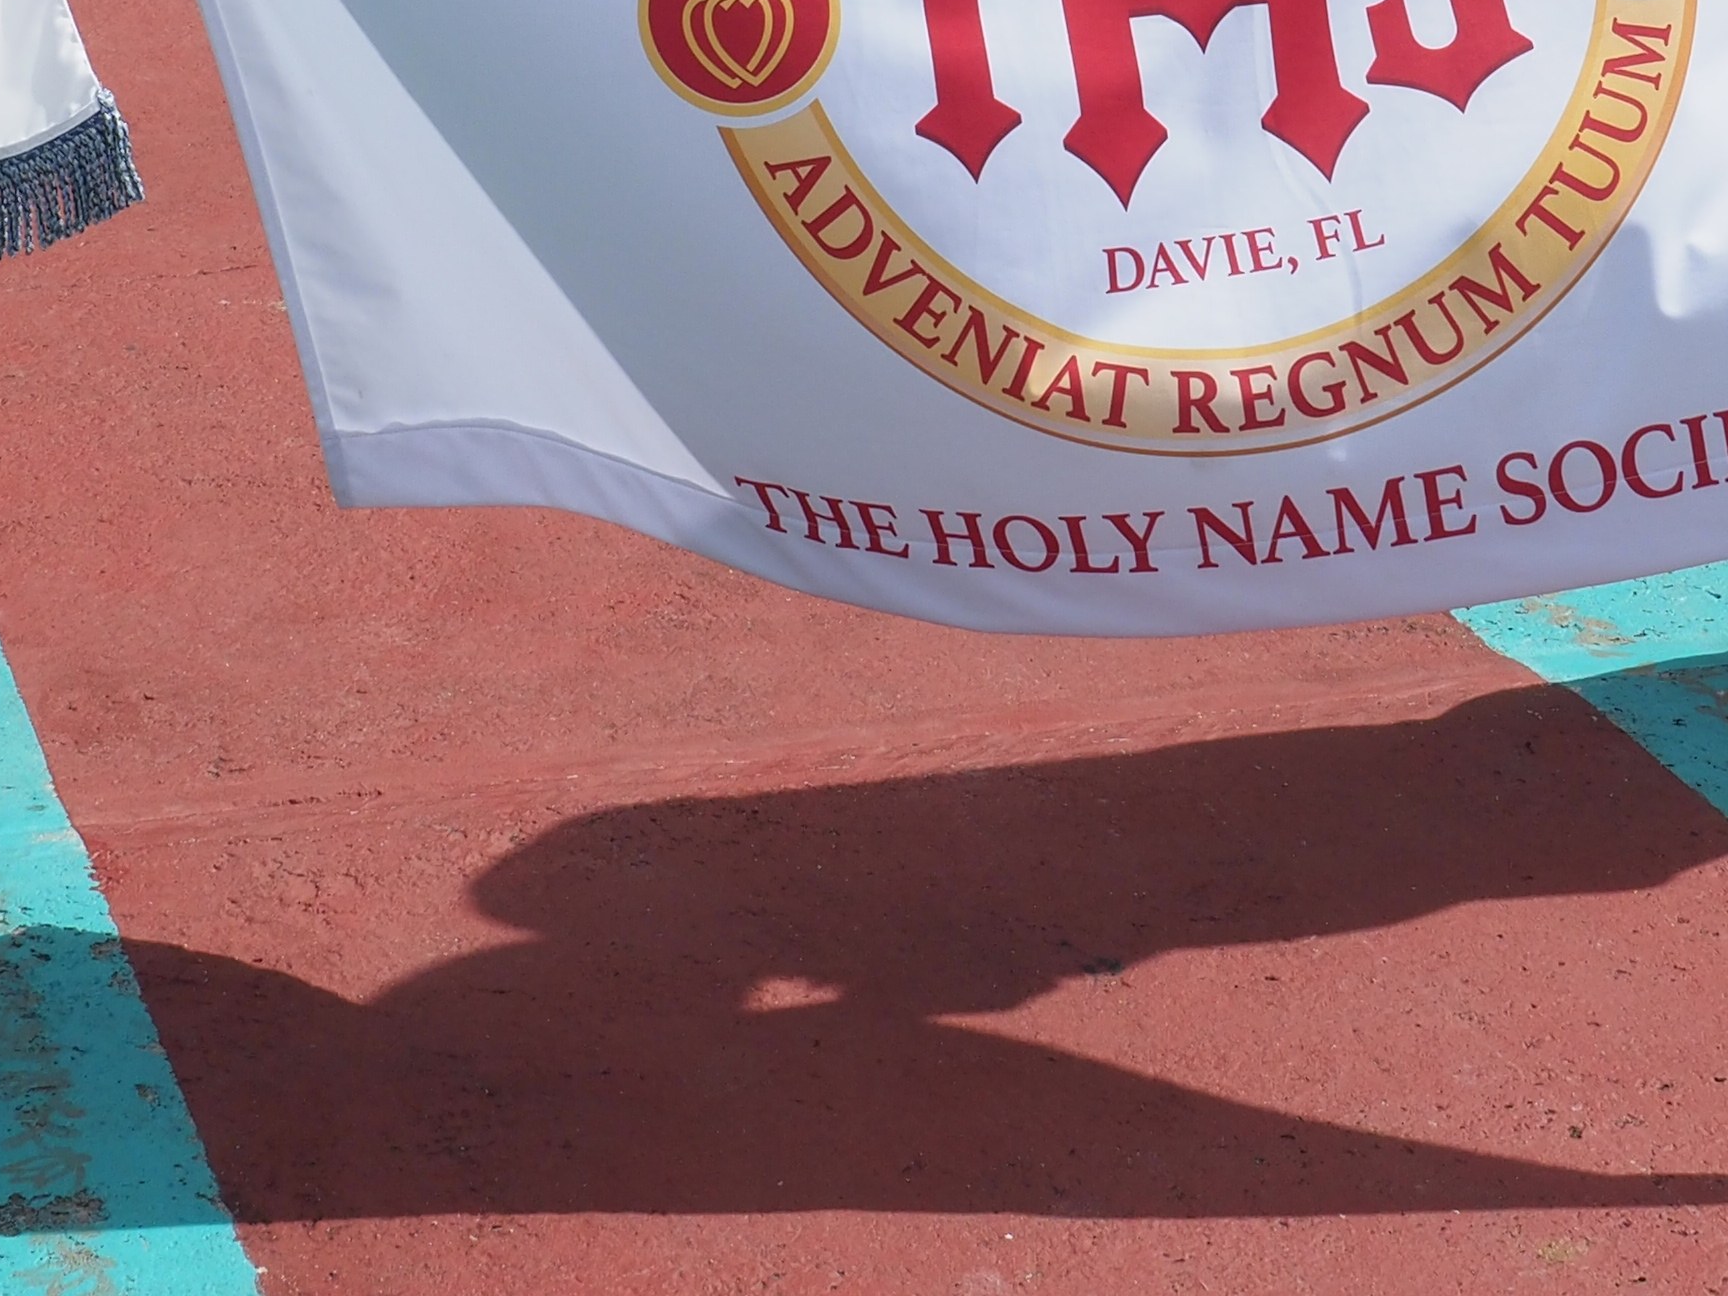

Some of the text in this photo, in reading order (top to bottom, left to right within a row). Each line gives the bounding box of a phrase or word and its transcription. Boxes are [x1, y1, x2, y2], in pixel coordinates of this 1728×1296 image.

[762, 15, 1673, 434] ADVENIAT REGNUM TUUM
[1101, 209, 1386, 295] DAVIE, FL
[733, 476, 911, 560] THE
[917, 507, 1166, 574] HOLY
[1186, 464, 1478, 569] NAME
